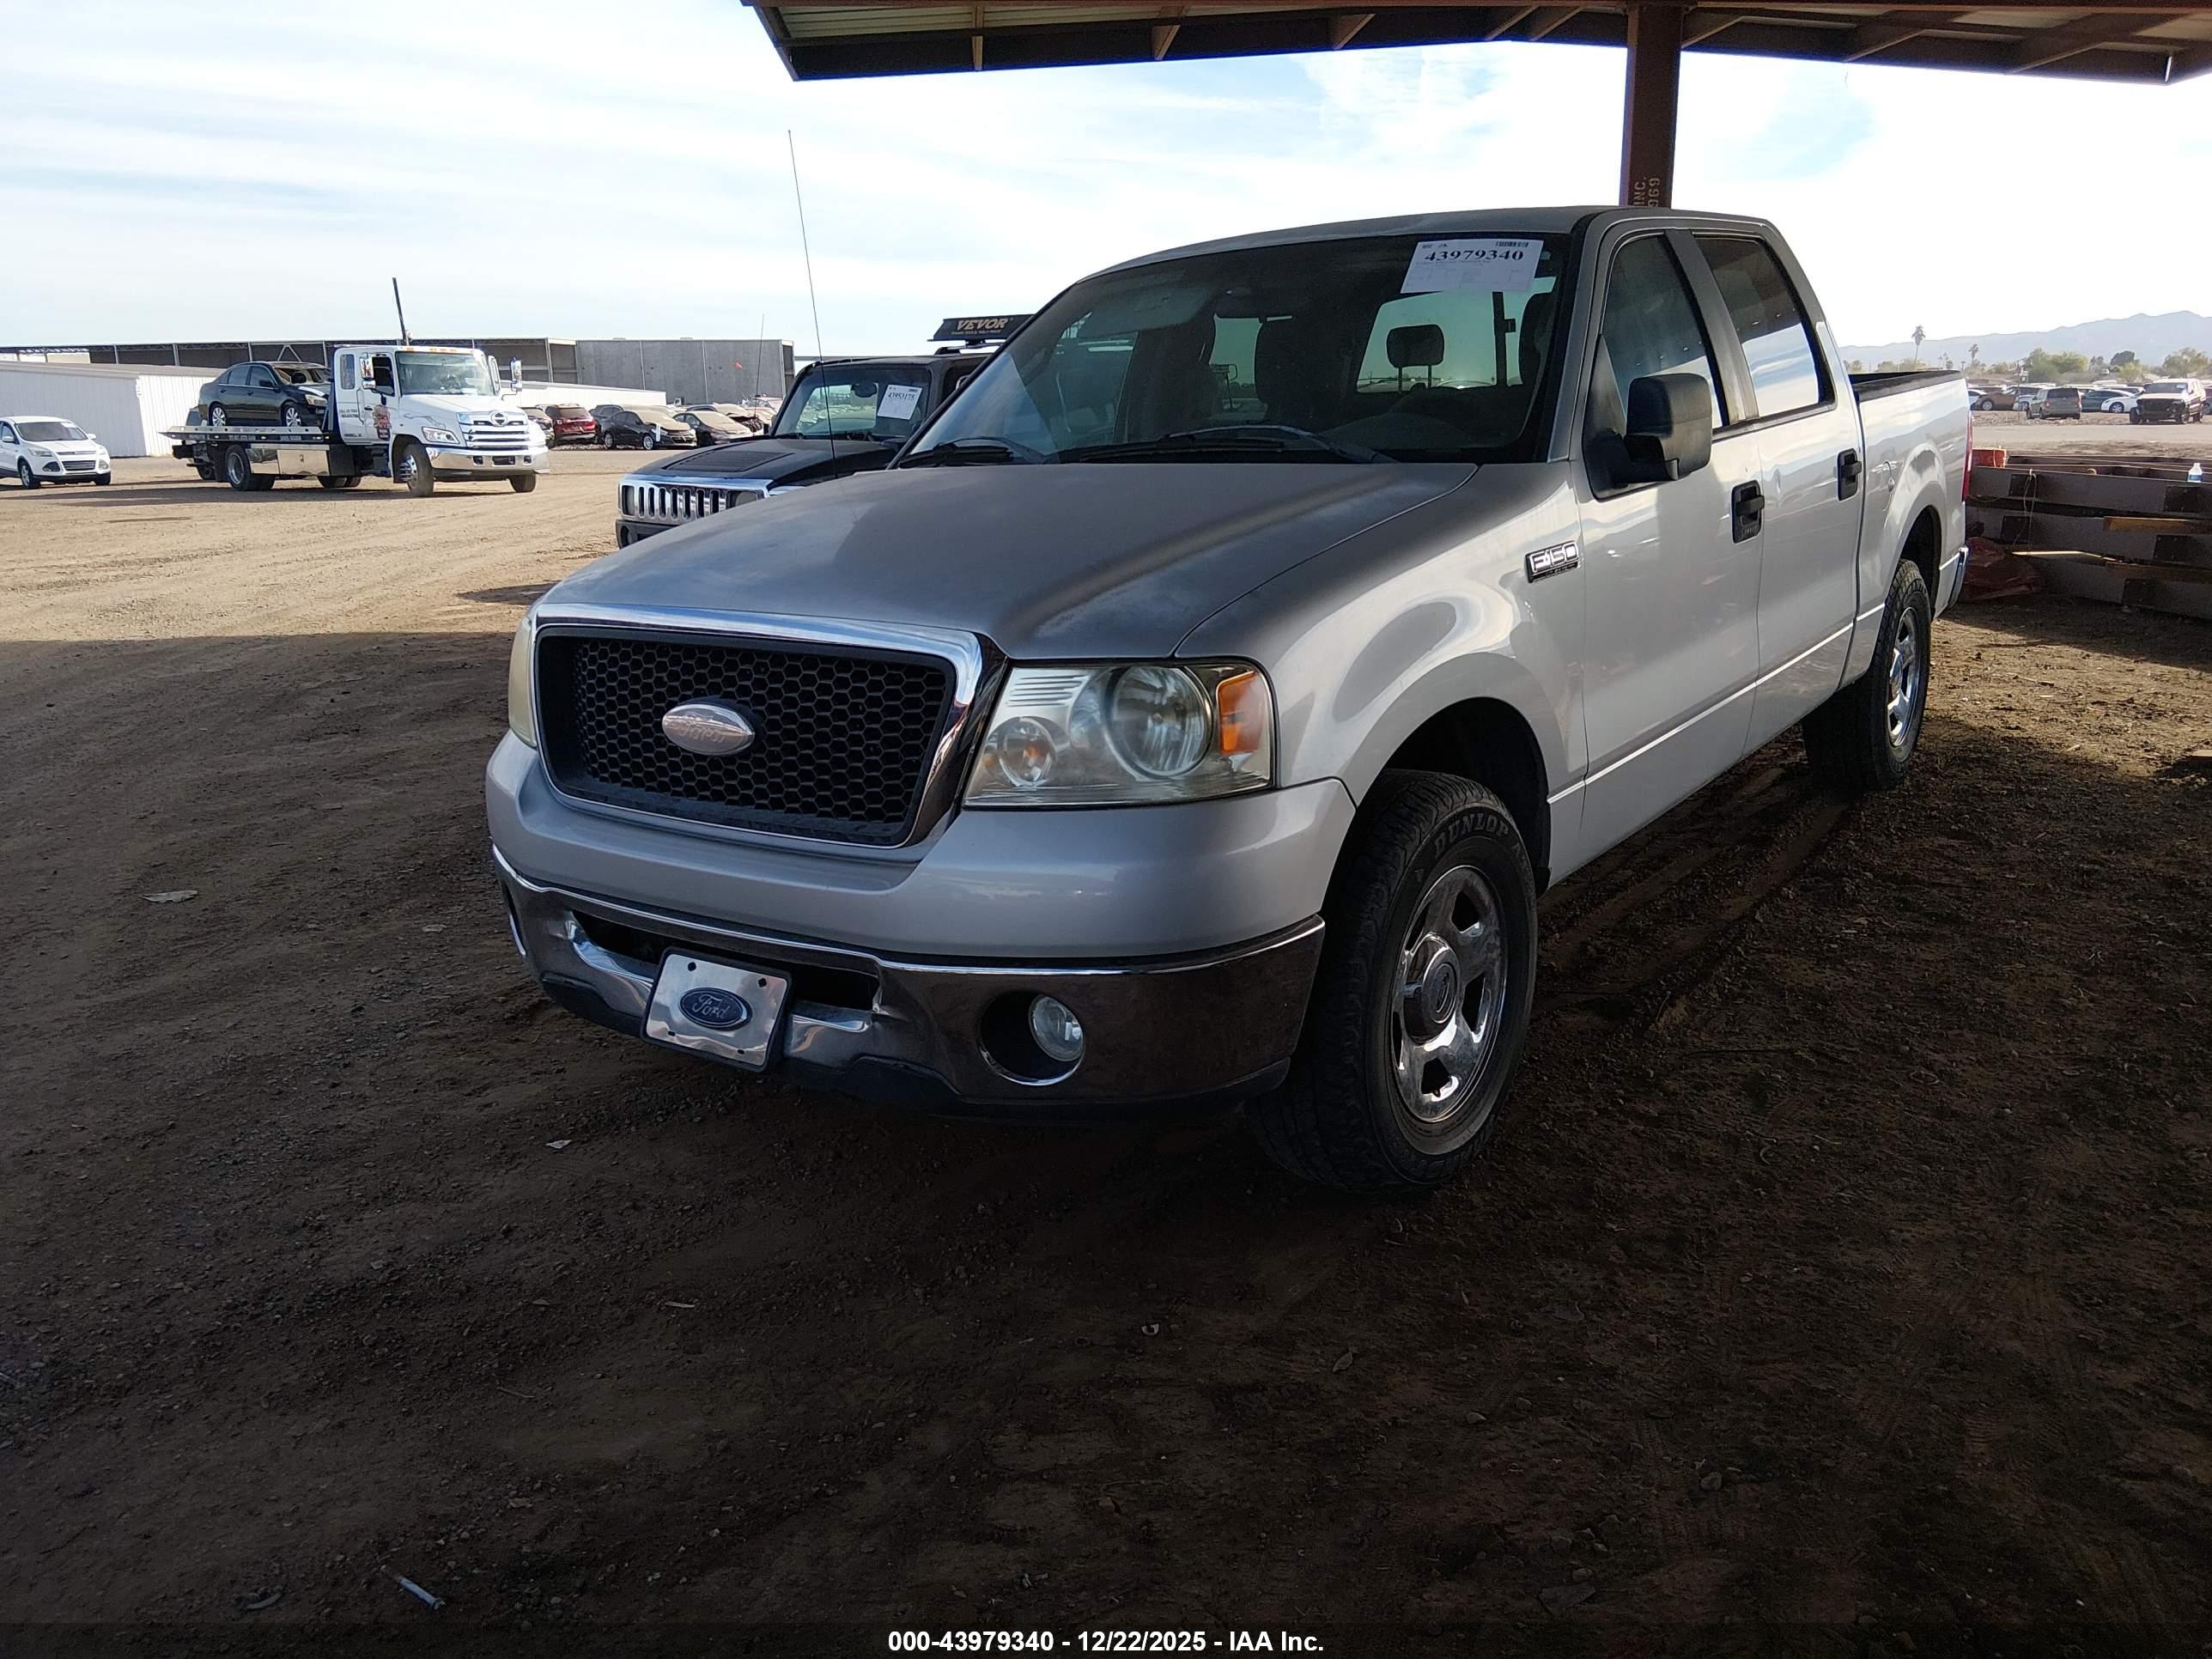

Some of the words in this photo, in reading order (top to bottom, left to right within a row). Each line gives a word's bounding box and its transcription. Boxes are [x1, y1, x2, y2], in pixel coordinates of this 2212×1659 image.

[1632, 176, 1647, 206] INC.
[1424, 249, 1524, 262] 43979340
[956, 318, 1009, 331] VEVOR
[1434, 811, 1510, 860] DUNLOP
[692, 994, 731, 1018] Ford
